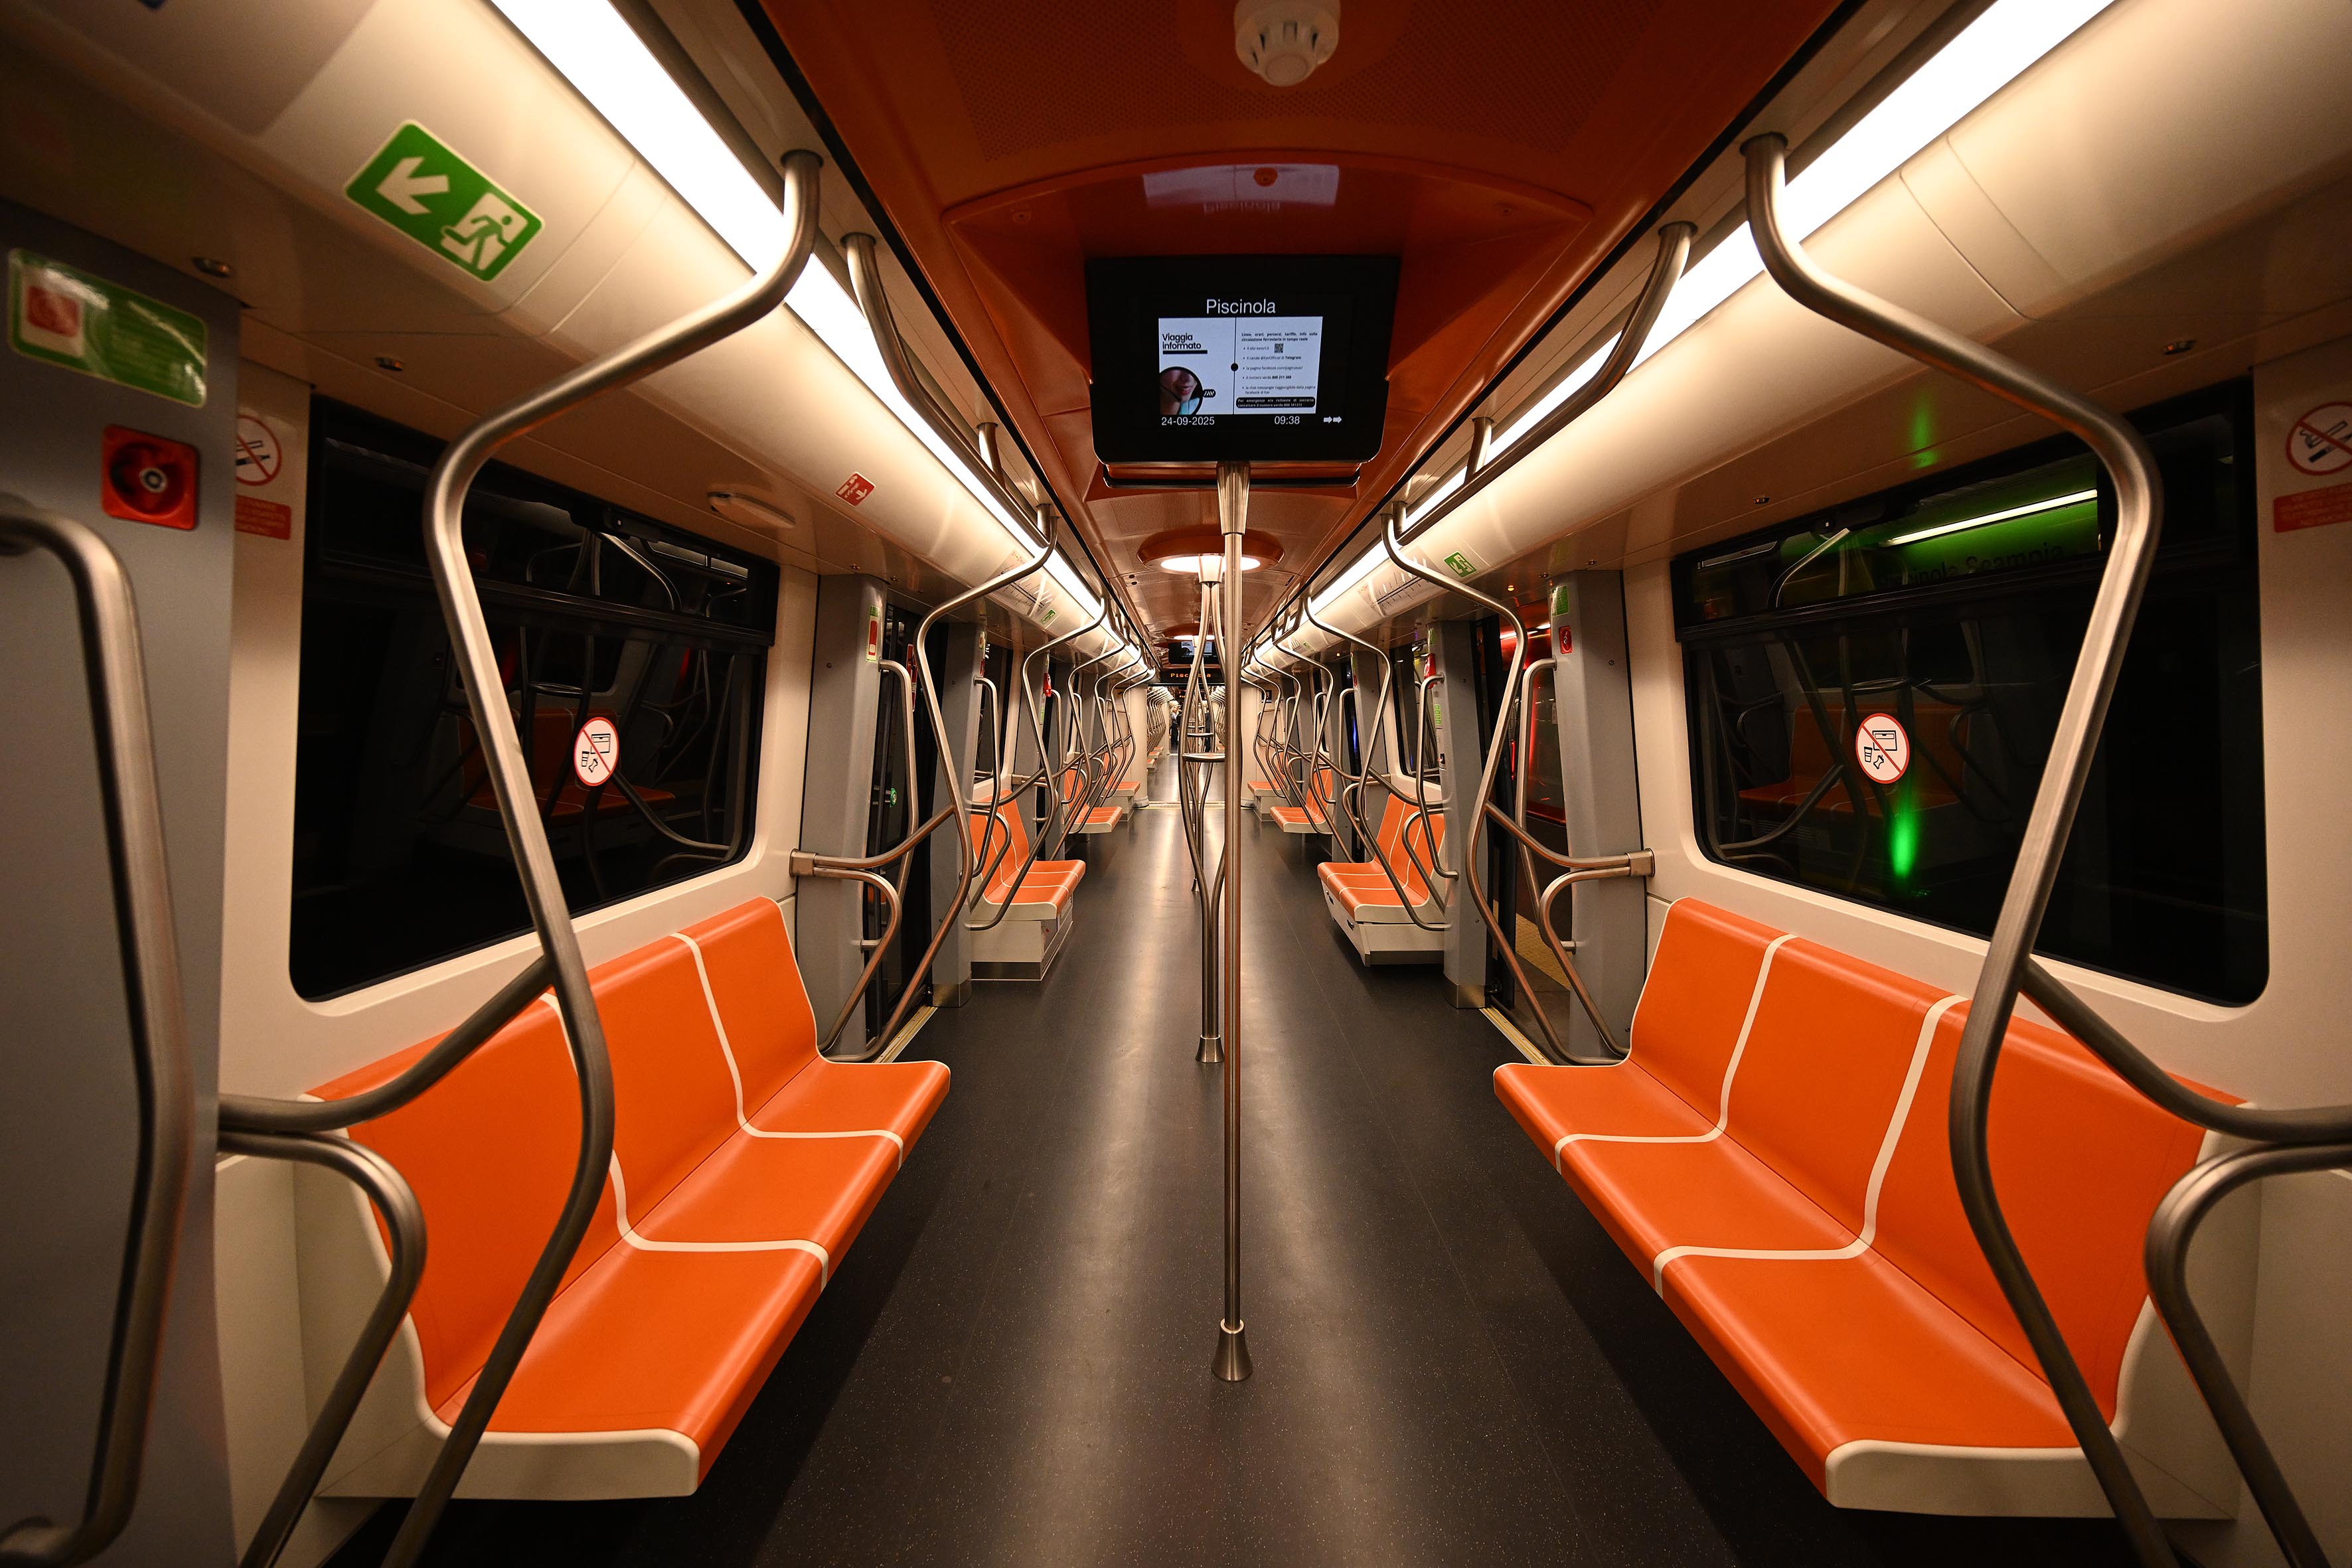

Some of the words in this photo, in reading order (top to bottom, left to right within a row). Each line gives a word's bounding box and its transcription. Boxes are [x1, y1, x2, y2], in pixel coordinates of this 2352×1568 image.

[1206, 298, 1276, 314] Piscinola
[1162, 333, 1193, 343] Viaggia
[1161, 416, 1215, 426] 24-09-2025
[1274, 415, 1300, 425] 09:38
